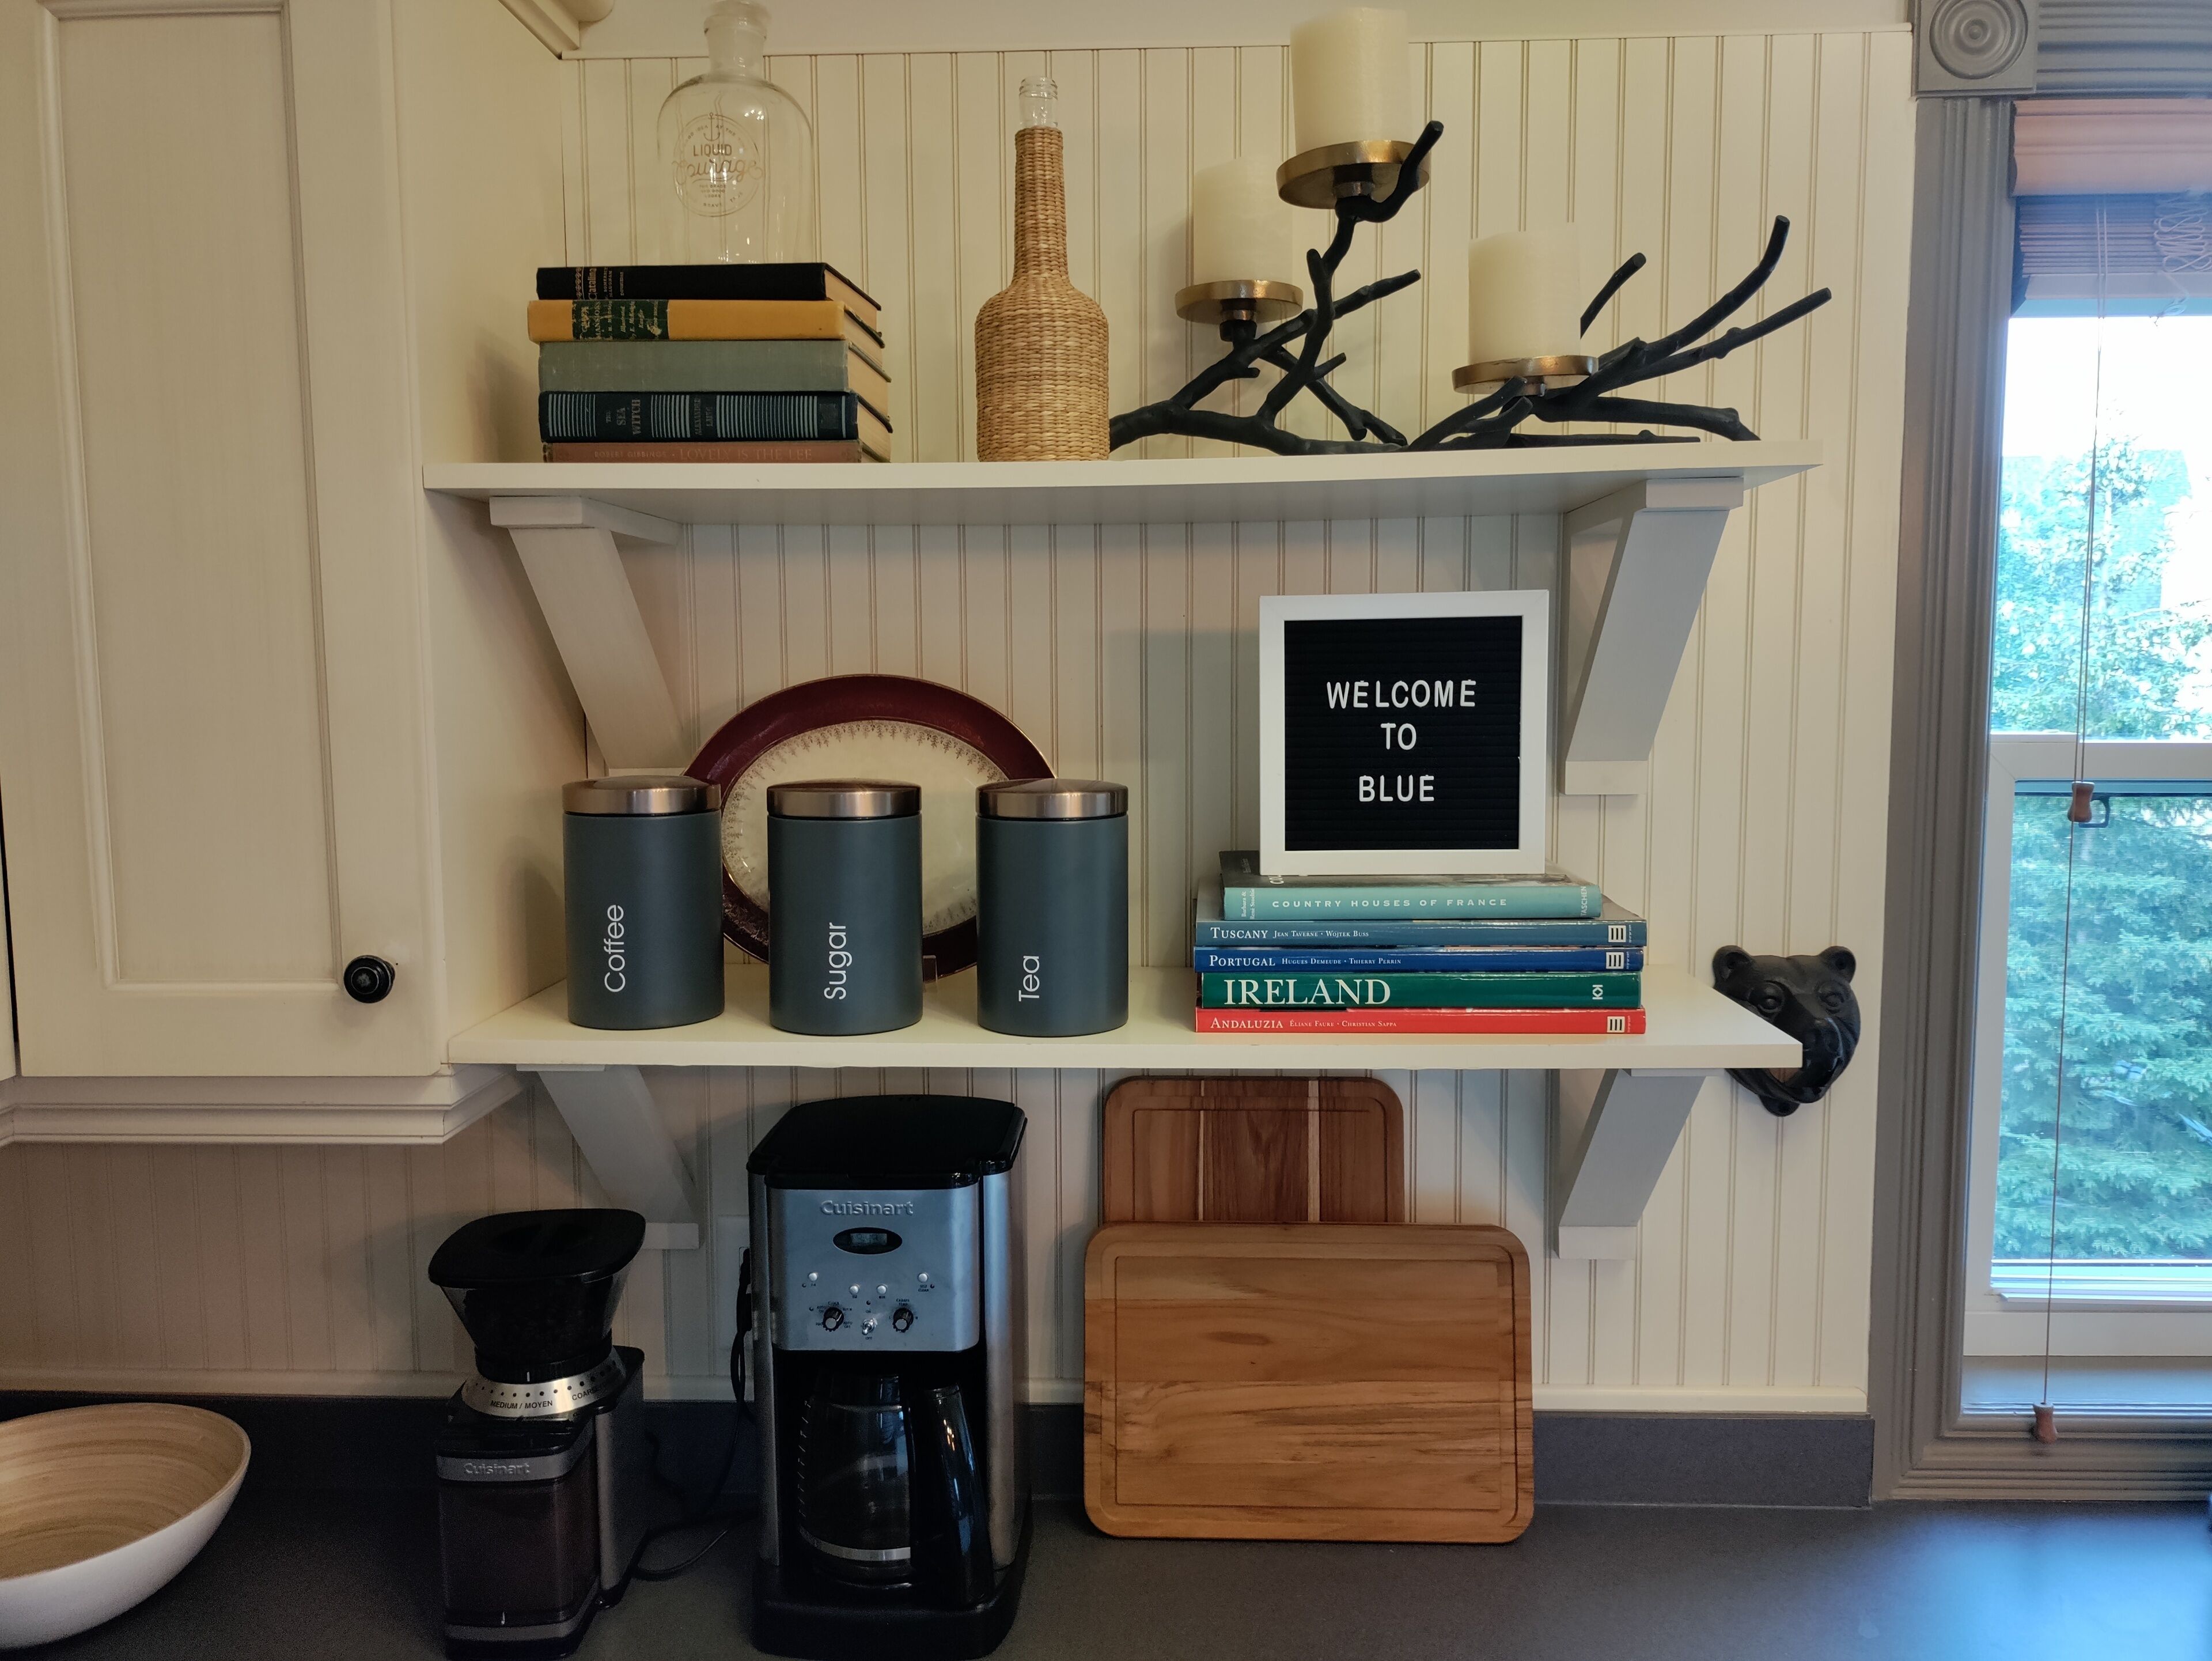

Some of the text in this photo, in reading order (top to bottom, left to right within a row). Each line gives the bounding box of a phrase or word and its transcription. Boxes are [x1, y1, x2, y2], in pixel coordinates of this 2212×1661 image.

[693, 144, 732, 157] LIQUID
[588, 268, 597, 300] Catalina
[616, 407, 626, 426] SEA
[631, 398, 641, 434] WITCH
[680, 448, 732, 460] LOVELY
[738, 448, 748, 460] IS
[755, 448, 782, 460] THE
[789, 448, 812, 460] LEE
[1327, 679, 1476, 709] WELCOME
[1381, 722, 1416, 750] TO
[1359, 774, 1434, 802] BLUE
[1272, 900, 1342, 908] COUNTRY
[1351, 899, 1411, 907] HOUSES
[1210, 927, 1268, 939] TUSCANY
[604, 904, 626, 993] Coffee
[824, 922, 852, 1000] Sugar
[1210, 955, 1275, 966] PORTUGAL
[1018, 955, 1040, 1002] Tea
[1224, 978, 1391, 1005] IRELAND
[1210, 1017, 1283, 1028] ANDALUZIA
[821, 1200, 914, 1216] Cuisinart
[490, 1399, 518, 1409] MEDIUM
[525, 1400, 553, 1409] MOYEN
[464, 1463, 530, 1474] Cuisinart
